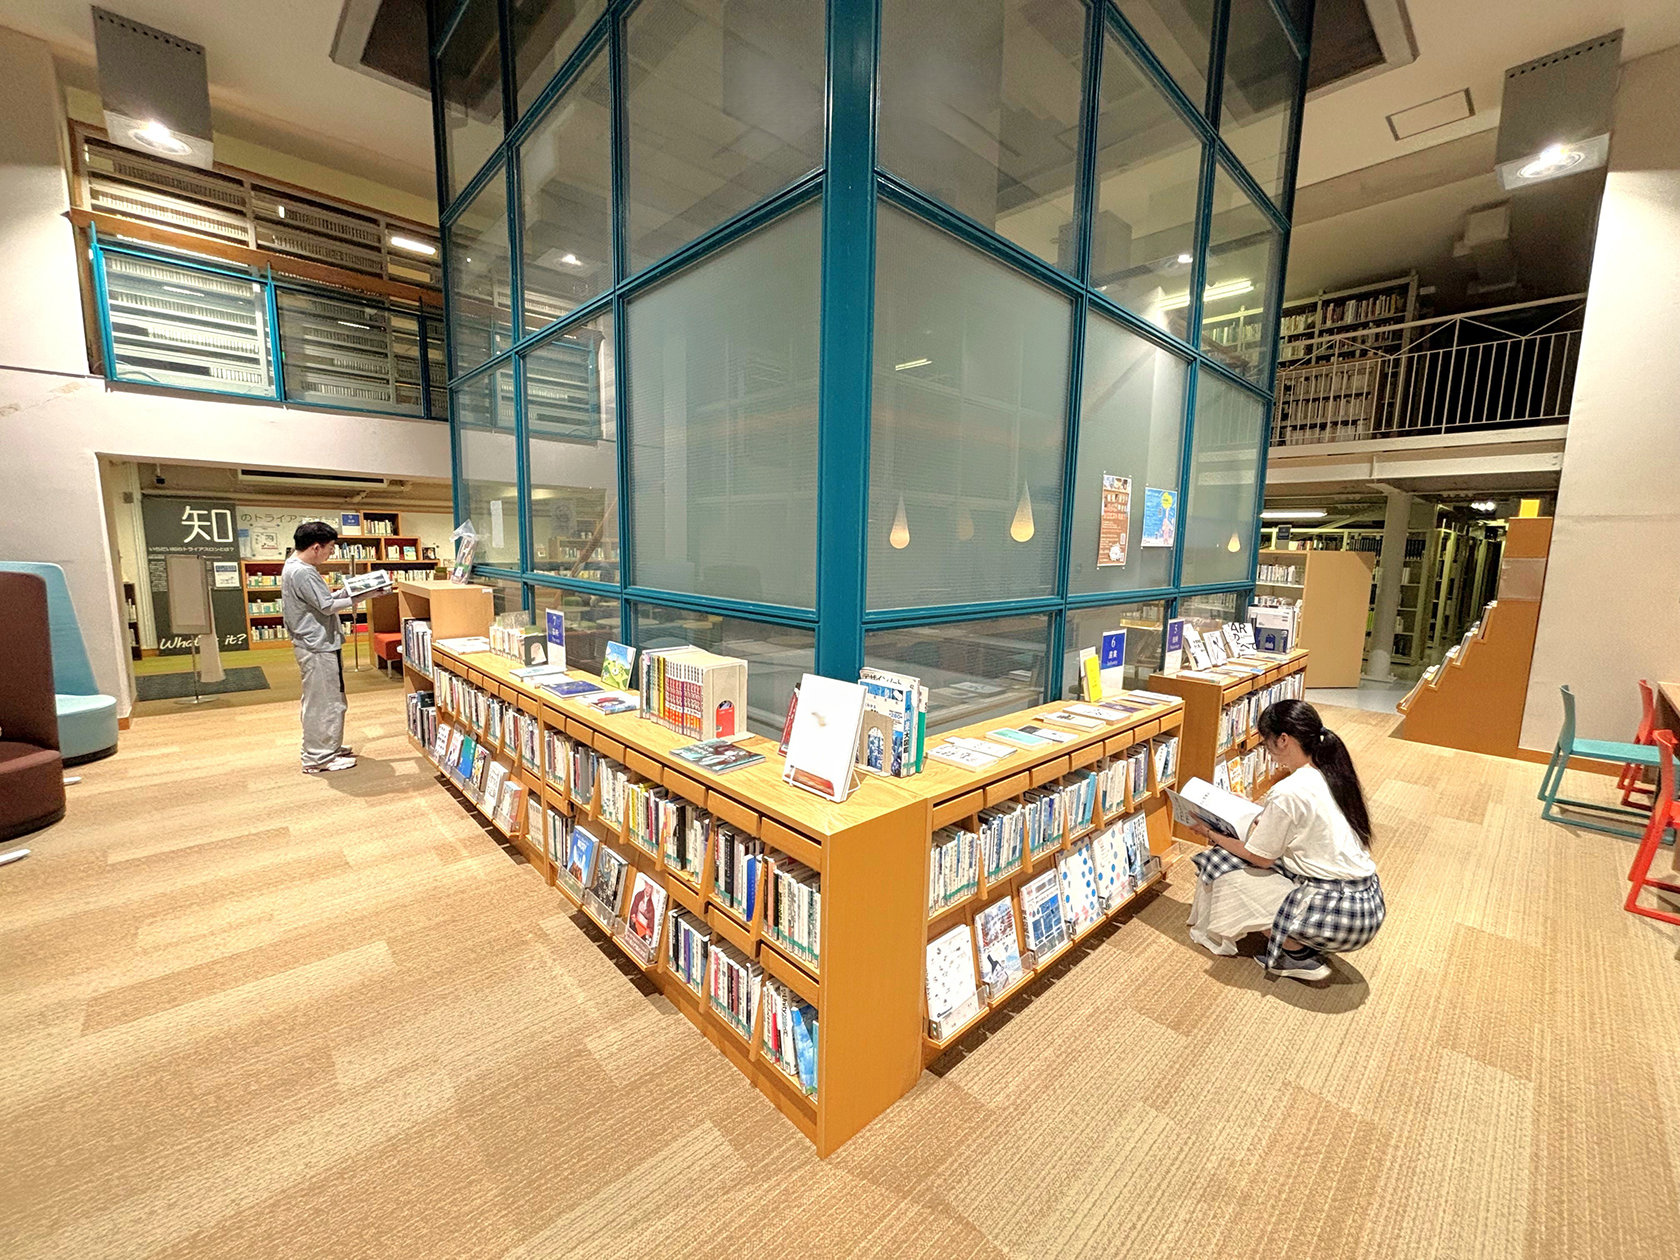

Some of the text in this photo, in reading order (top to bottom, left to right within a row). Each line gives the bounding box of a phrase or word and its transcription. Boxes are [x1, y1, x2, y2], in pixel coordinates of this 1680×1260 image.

[181, 505, 233, 543] 知
[1230, 621, 1248, 634] AR
[224, 633, 247, 646] it?
[1110, 636, 1116, 648] 6
